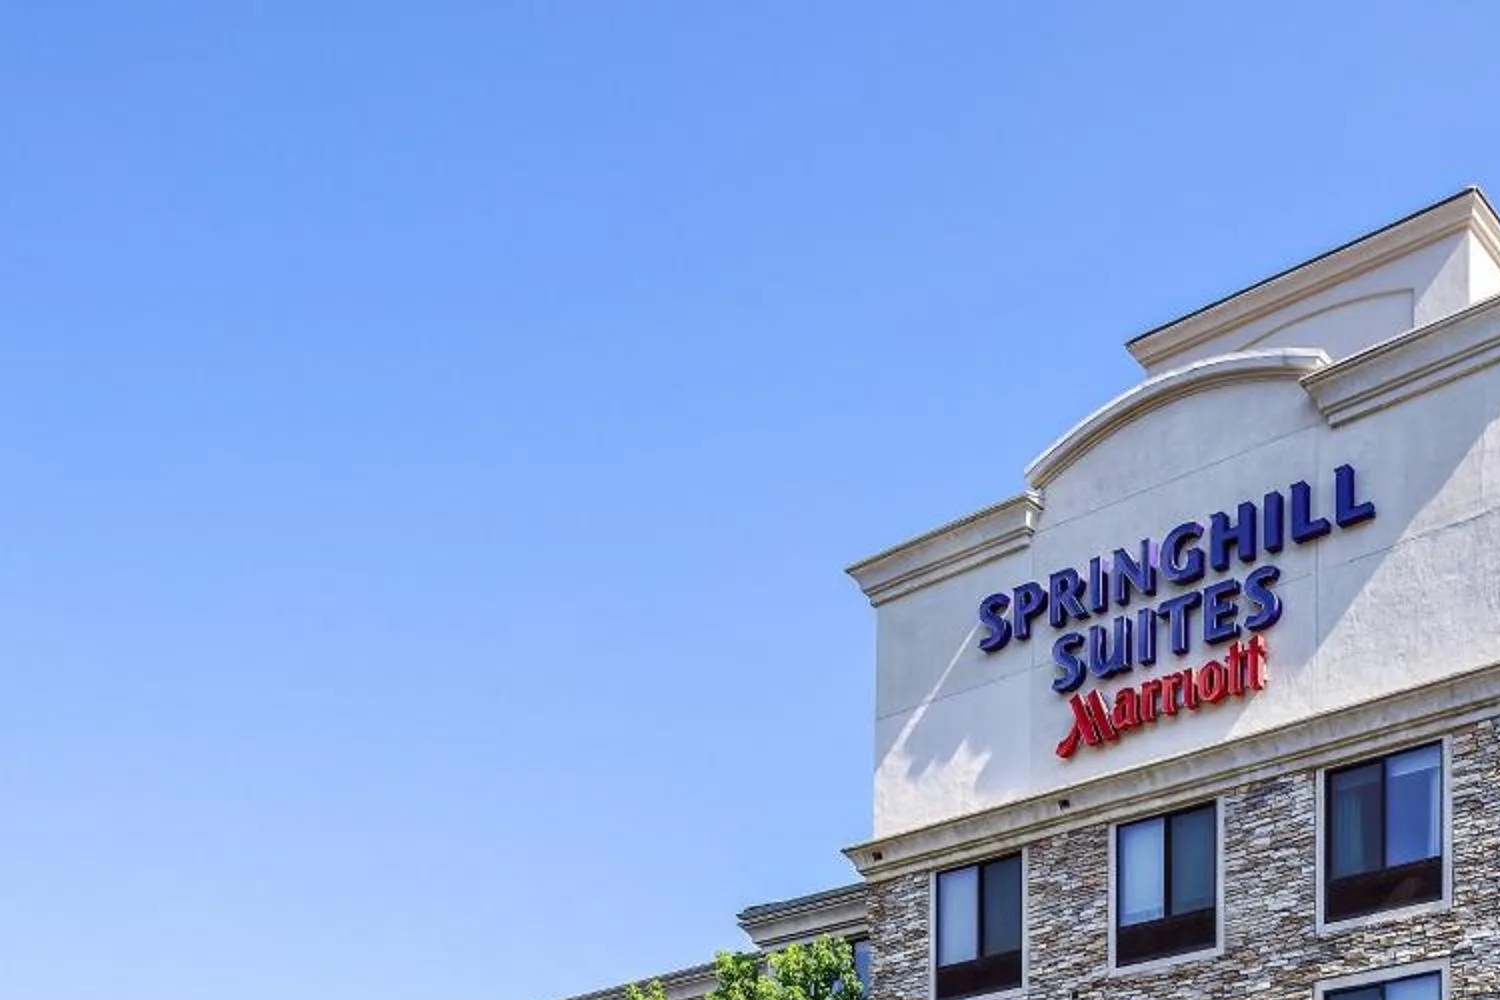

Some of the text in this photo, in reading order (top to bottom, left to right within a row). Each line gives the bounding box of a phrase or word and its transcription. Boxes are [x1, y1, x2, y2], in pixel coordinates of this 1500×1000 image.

[979, 463, 1376, 653] SPRINGHILL
[1052, 565, 1283, 693] SUITES
[1056, 635, 1267, 758] Marriott
